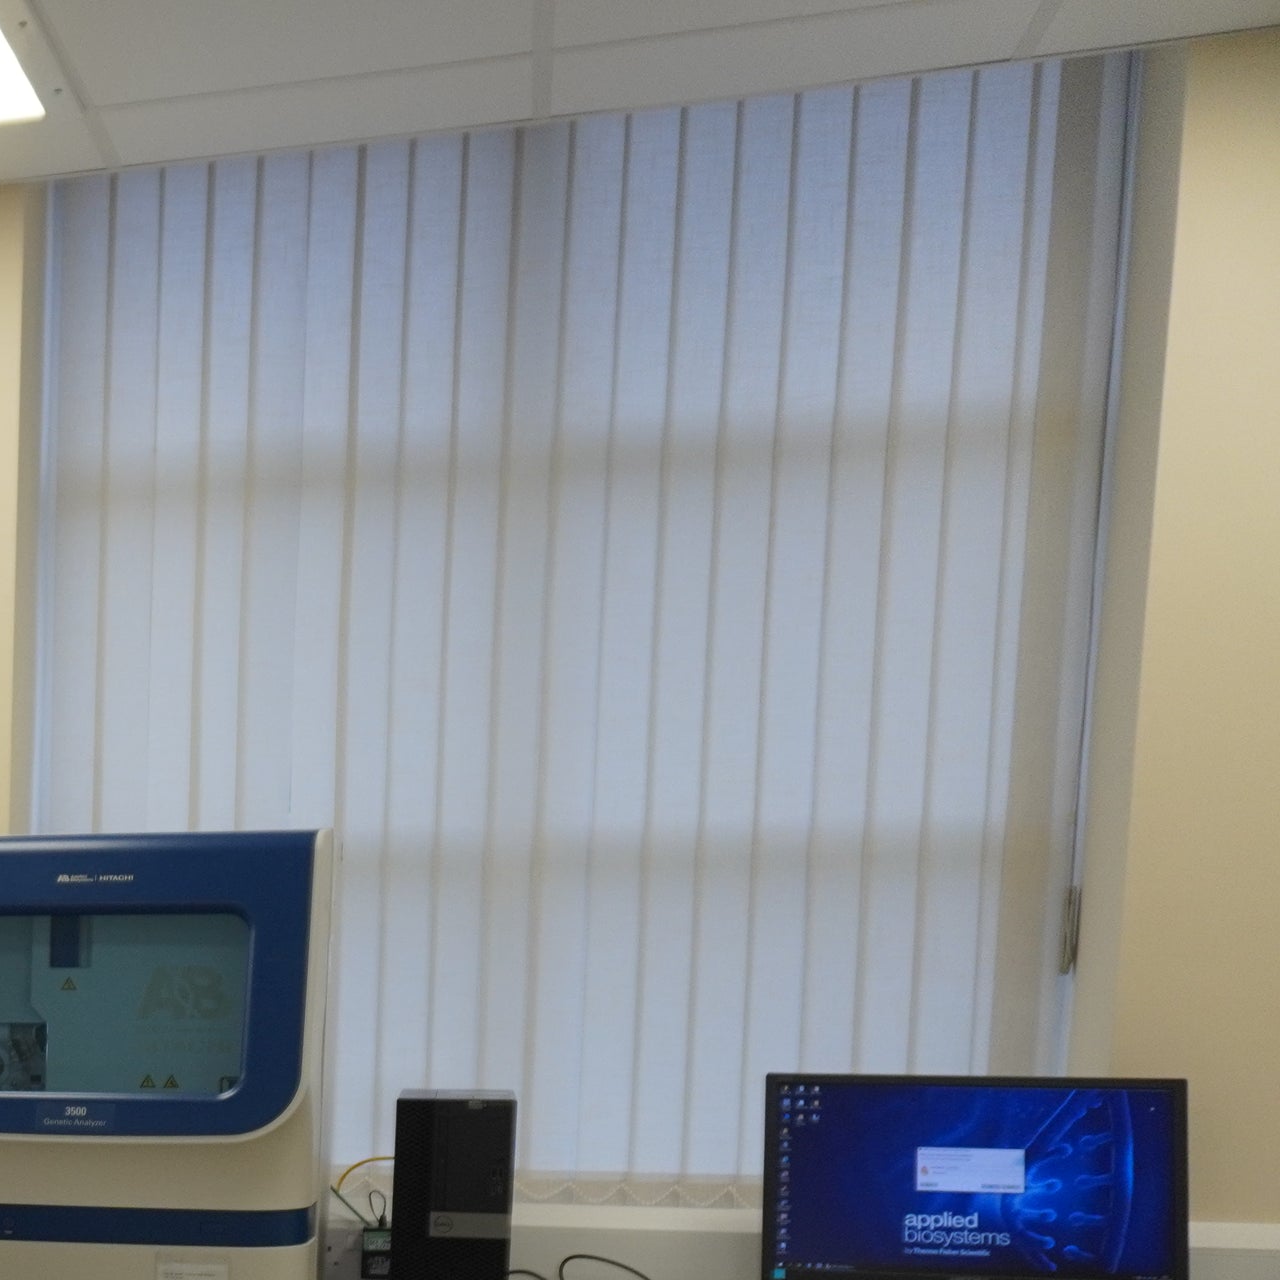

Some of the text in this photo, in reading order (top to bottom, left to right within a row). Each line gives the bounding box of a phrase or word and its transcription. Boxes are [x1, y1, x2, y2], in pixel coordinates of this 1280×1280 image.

[65, 1106, 87, 1116] 3500
[43, 1118, 106, 1127] Genetic Analyzer
[904, 1211, 978, 1230] applied
[904, 1227, 1011, 1247] biosystems
